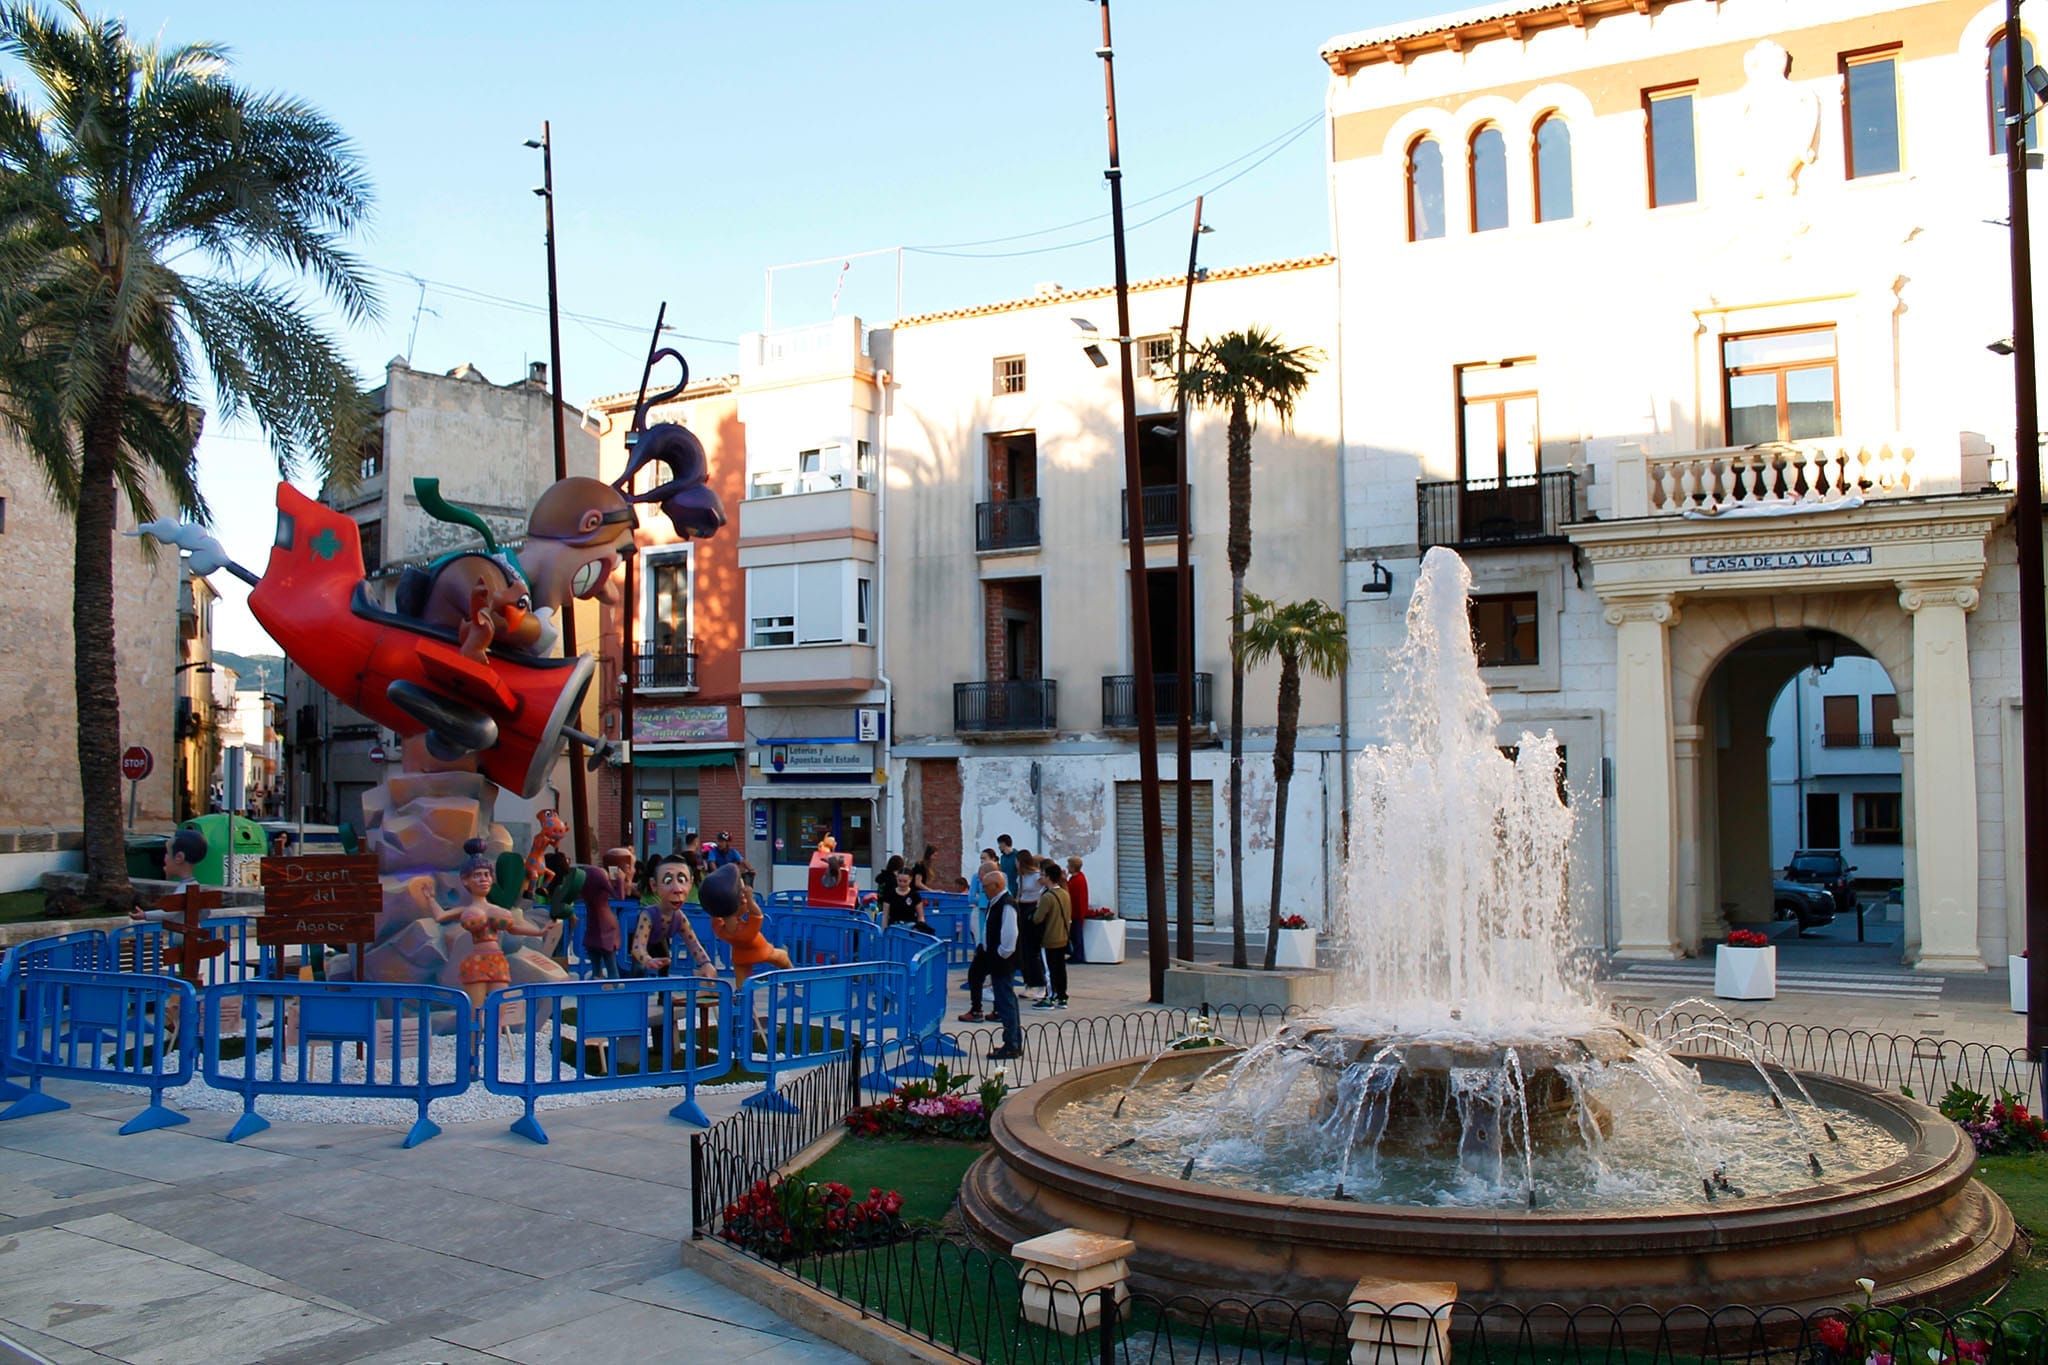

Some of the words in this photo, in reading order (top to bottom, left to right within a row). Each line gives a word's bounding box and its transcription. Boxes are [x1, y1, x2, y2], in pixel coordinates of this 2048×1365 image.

[1706, 558, 1748, 570] CASA
[1753, 556, 1773, 568] DE
[1778, 555, 1798, 566] LA
[1804, 552, 1855, 566] VILLA
[124, 759, 145, 768] STOP
[789, 756, 821, 765] Apuestas
[823, 755, 834, 764] del
[835, 754, 860, 764] Estado
[312, 887, 337, 902] del
